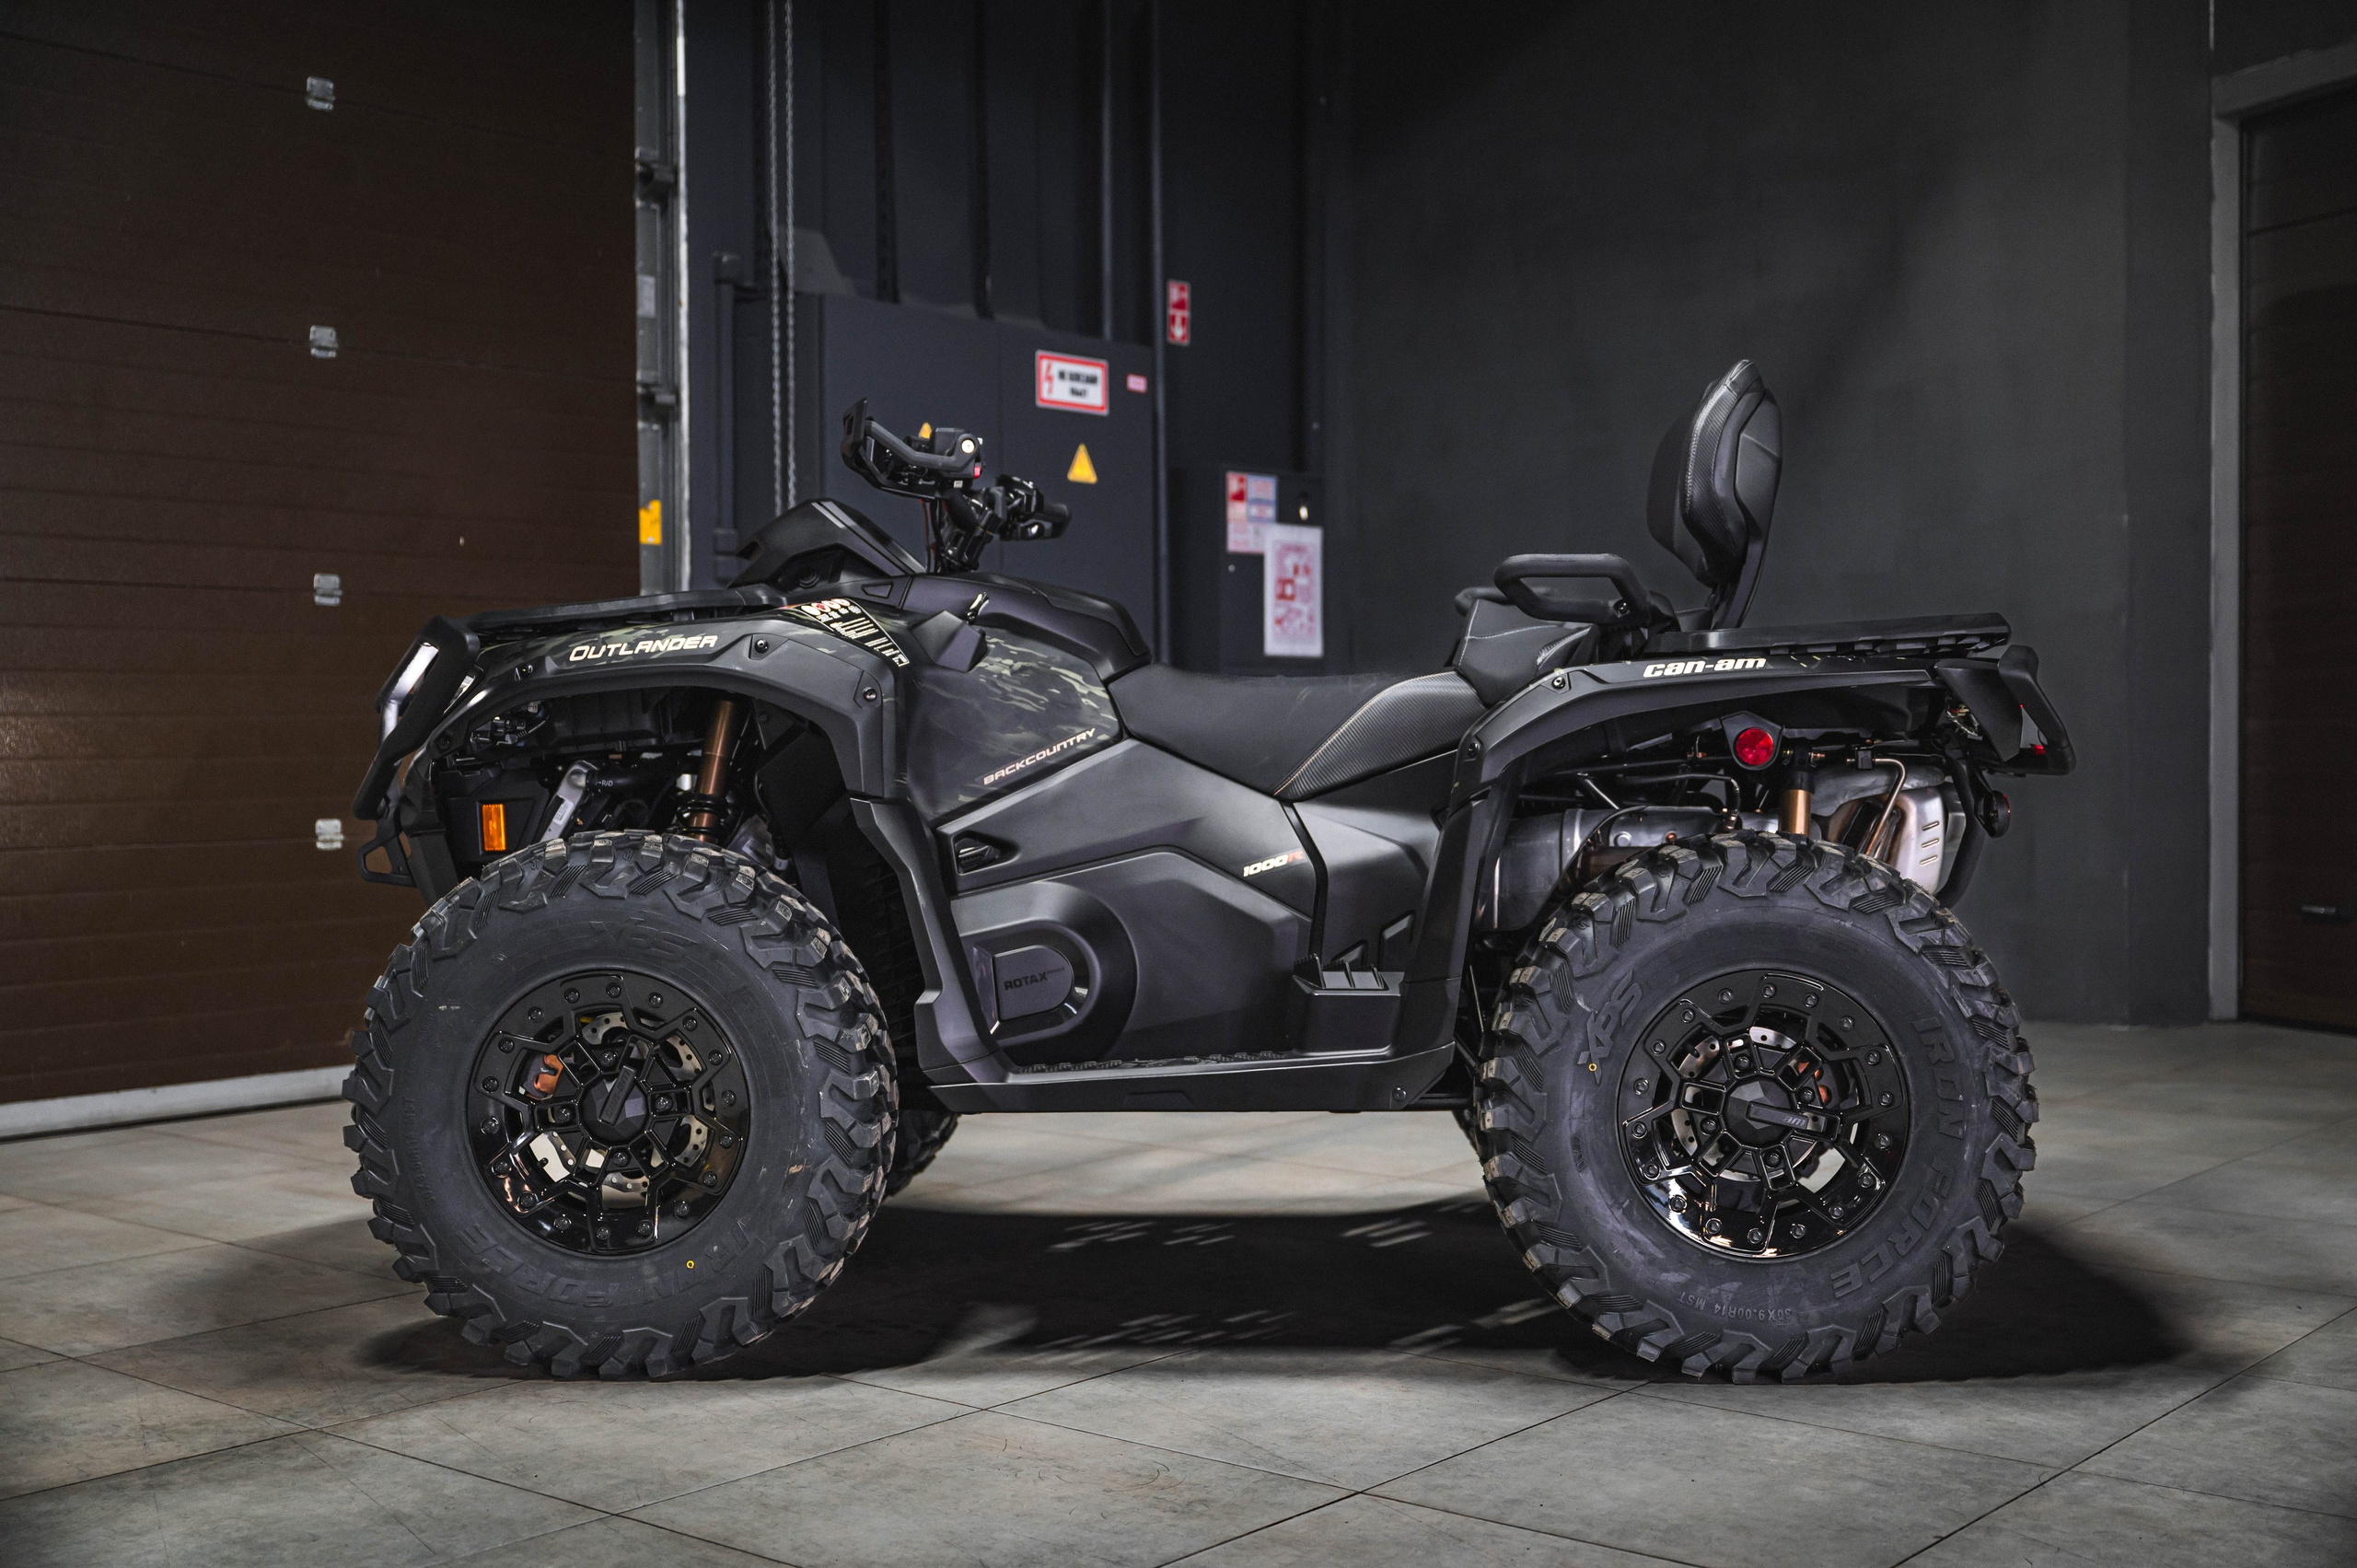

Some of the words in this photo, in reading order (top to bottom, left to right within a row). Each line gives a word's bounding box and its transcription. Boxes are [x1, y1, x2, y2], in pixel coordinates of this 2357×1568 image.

[569, 635, 718, 662] OUTLANDER
[1643, 657, 1767, 678] can-am
[983, 727, 1096, 785] BACKCOUNTRY
[1243, 850, 1304, 877] 1000R
[1004, 971, 1049, 991] ROTAX
[1910, 1016, 1964, 1141] IRON
[1829, 1156, 1954, 1299] FORCE
[1676, 1291, 1707, 1311] MST
